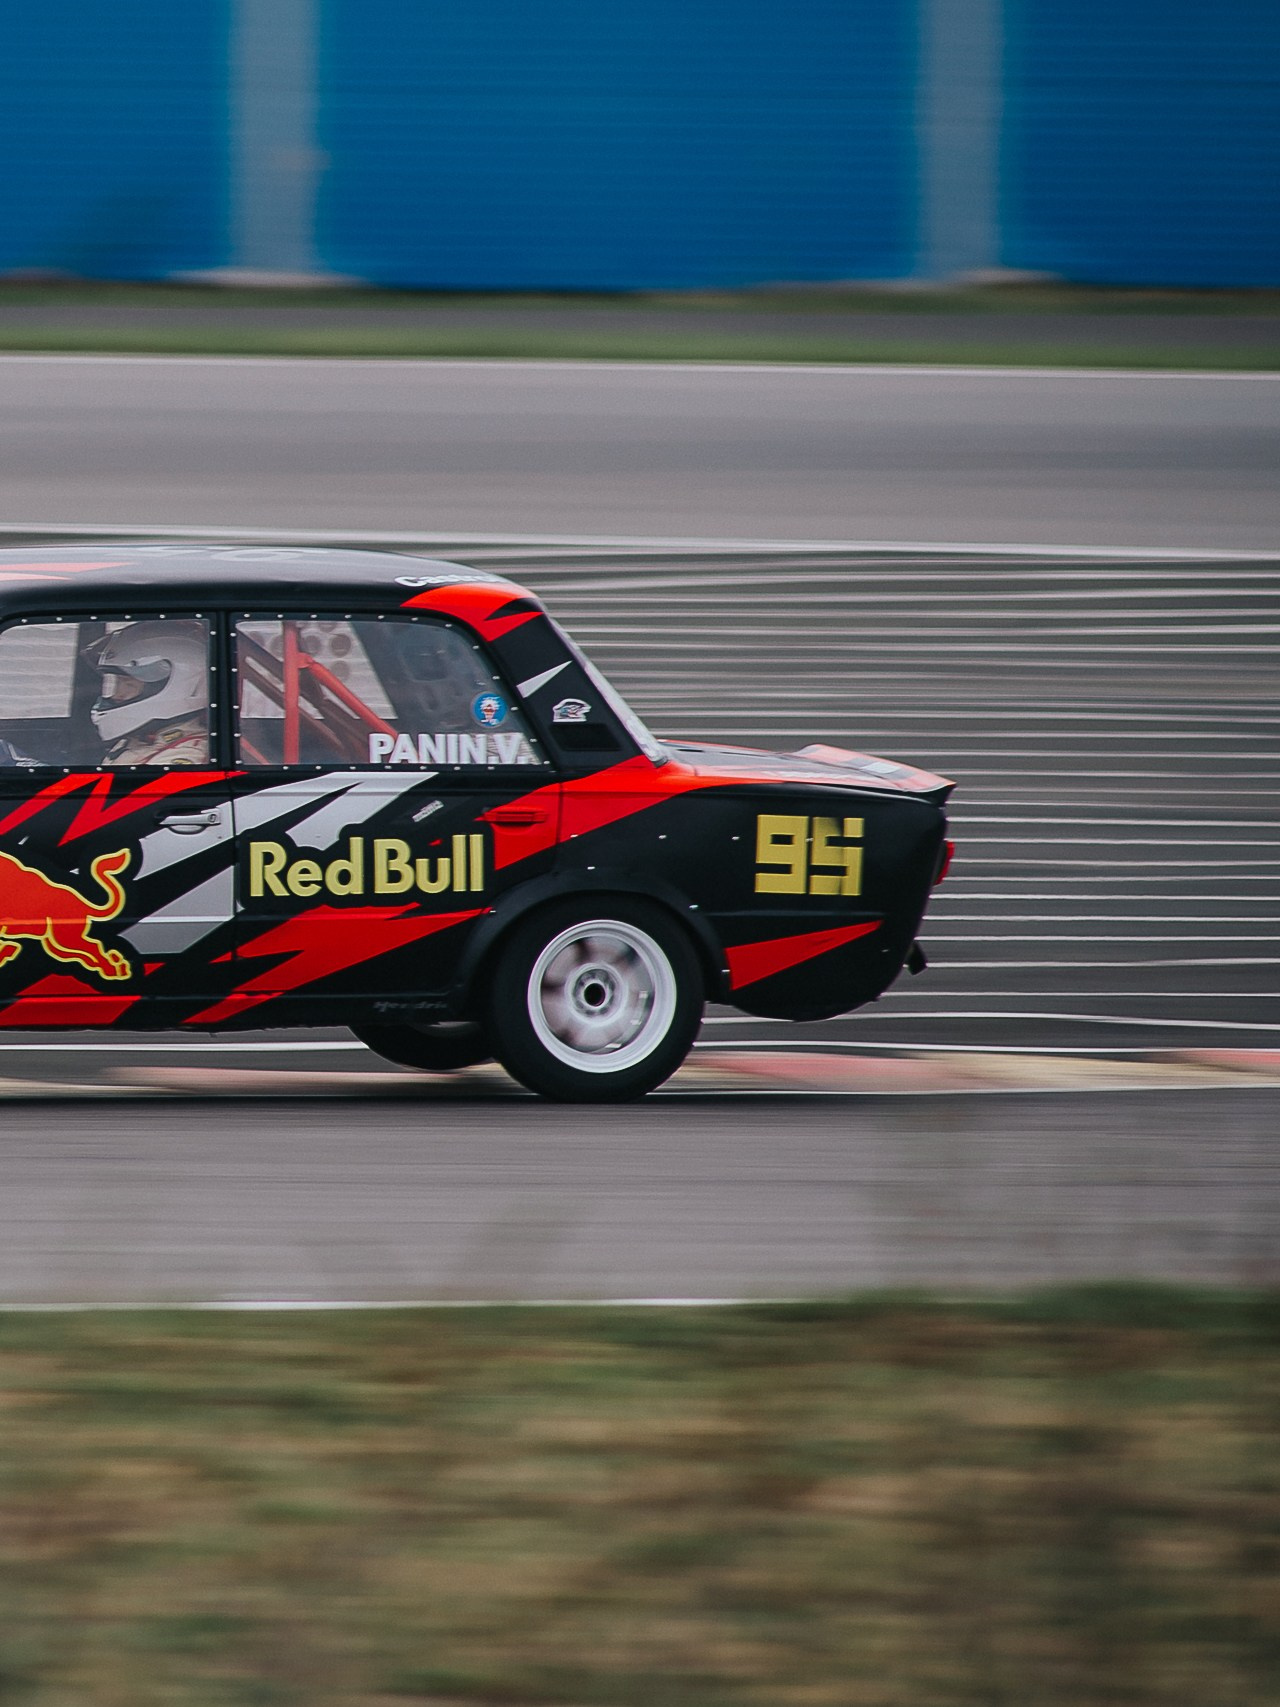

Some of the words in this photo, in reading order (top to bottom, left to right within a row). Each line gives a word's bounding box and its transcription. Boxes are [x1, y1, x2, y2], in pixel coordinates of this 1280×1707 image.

[368, 733, 528, 764] PANIN.V.
[249, 836, 364, 897] Red
[373, 833, 484, 894] Bull
[754, 814, 865, 896] 95
